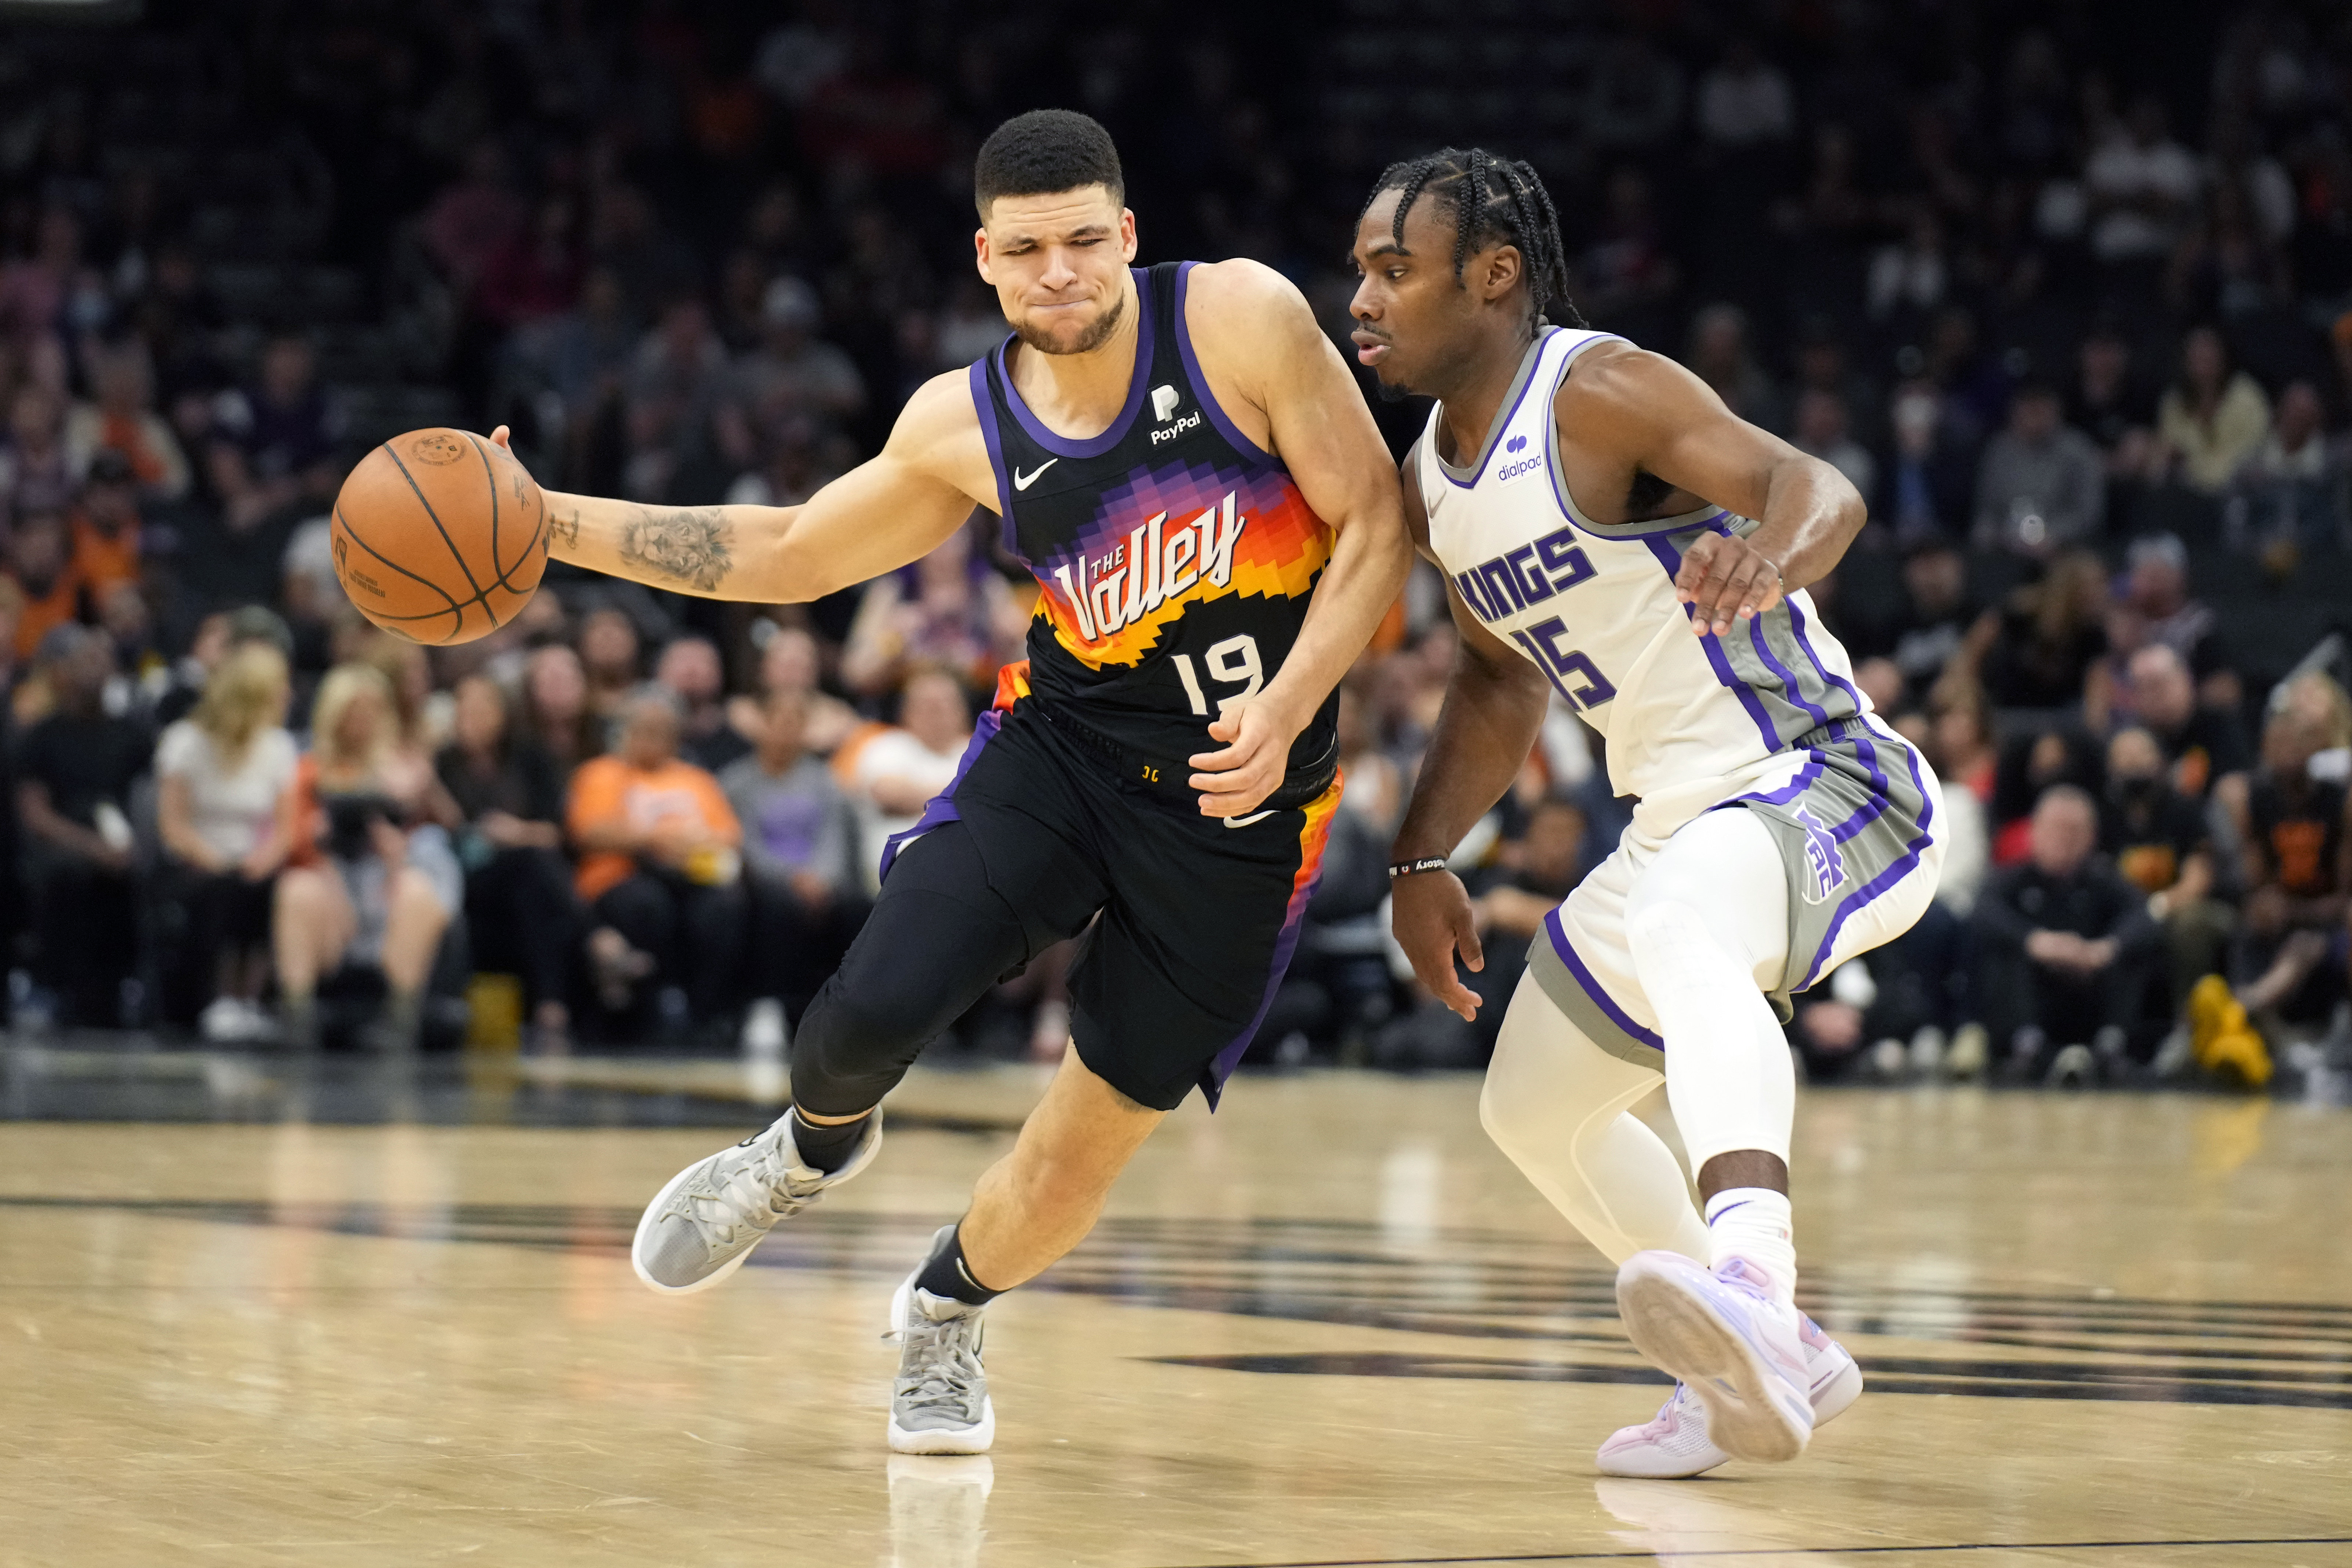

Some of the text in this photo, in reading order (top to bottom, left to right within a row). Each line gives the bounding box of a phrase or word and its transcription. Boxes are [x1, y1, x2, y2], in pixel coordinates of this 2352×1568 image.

[1151, 411, 1201, 445] PayPal
[1498, 451, 1541, 481] dialpad
[1054, 490, 1247, 641] Valley
[1090, 544, 1125, 579] THE
[1450, 525, 1598, 623] KINGS
[1170, 632, 1264, 715] 19
[1508, 614, 1618, 712] 15
